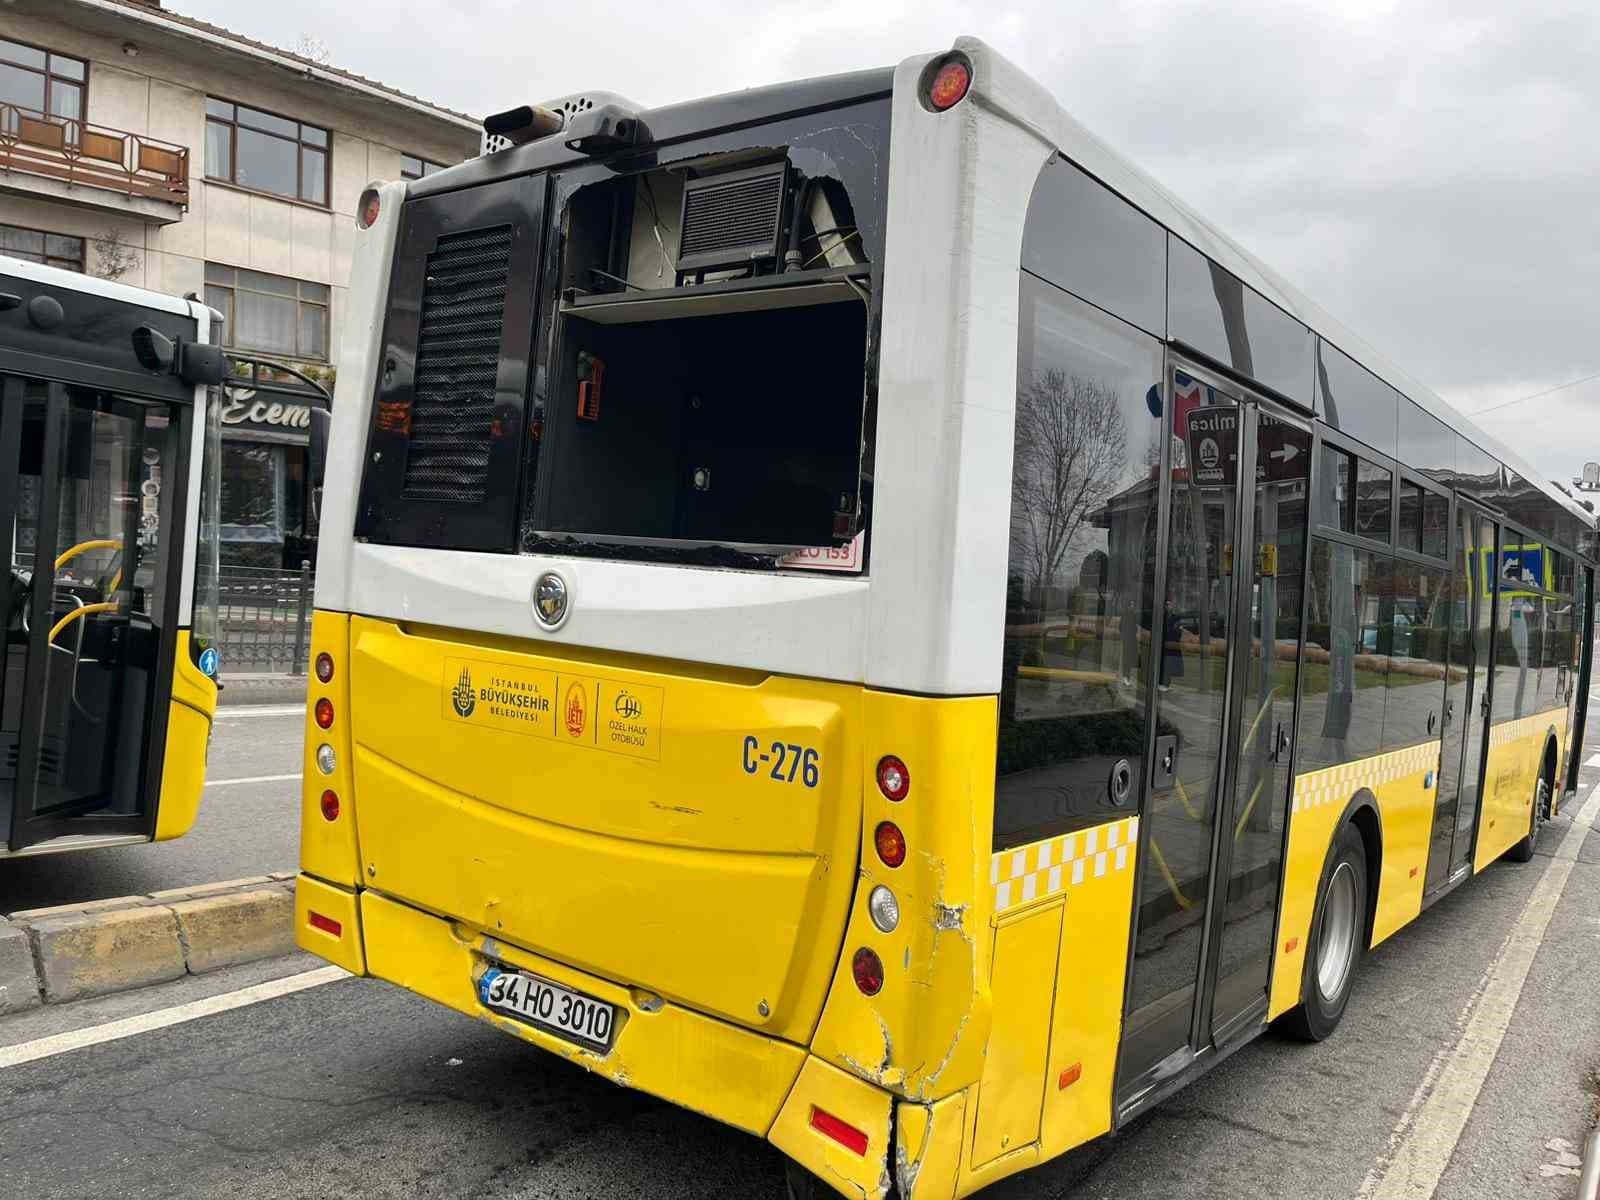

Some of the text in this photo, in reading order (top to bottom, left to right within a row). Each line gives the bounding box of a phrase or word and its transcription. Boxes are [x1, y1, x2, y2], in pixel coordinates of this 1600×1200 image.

[221, 387, 310, 428] Ecem
[826, 546, 849, 560] 153
[480, 687, 549, 711] BÜYÜKŞEHİR
[629, 722, 648, 735] HALK
[743, 735, 819, 788] C-276
[489, 976, 519, 1008] 34
[523, 981, 554, 1019] HO
[558, 994, 611, 1039] 3010
